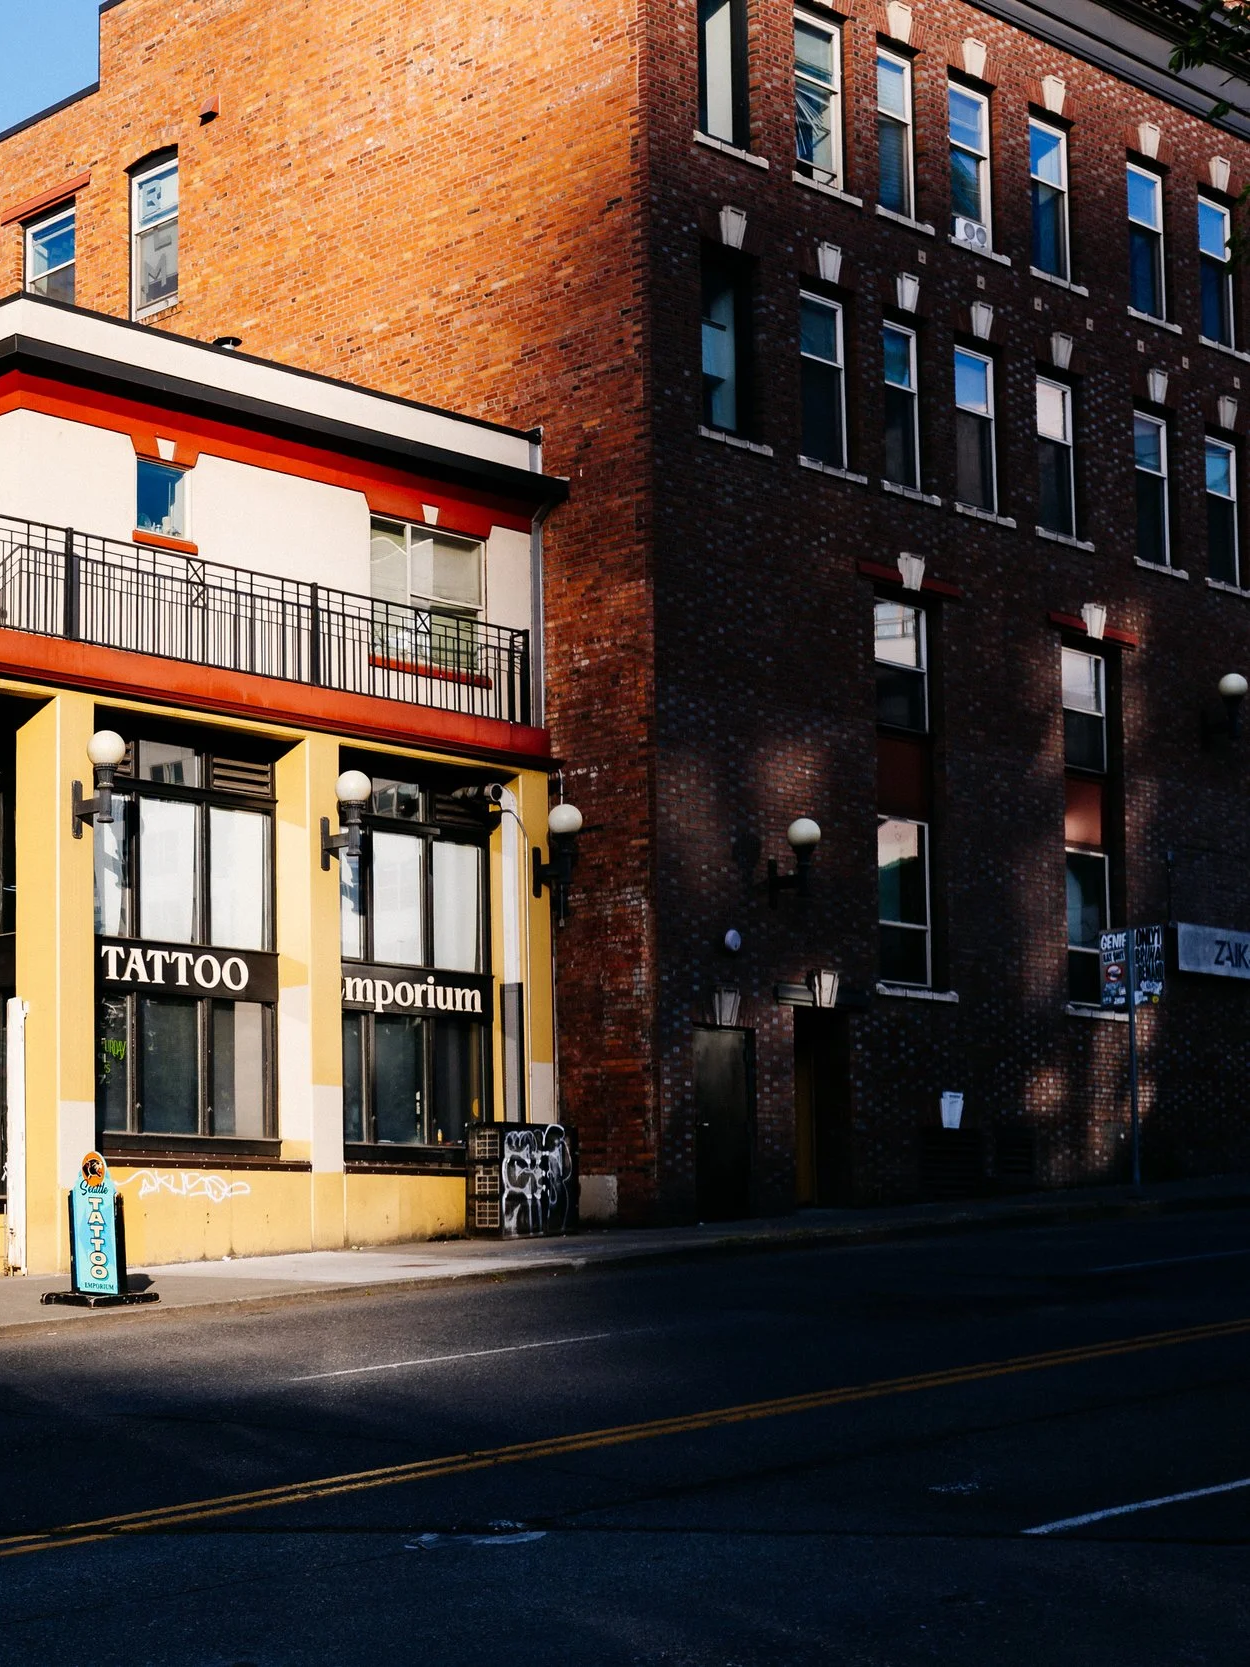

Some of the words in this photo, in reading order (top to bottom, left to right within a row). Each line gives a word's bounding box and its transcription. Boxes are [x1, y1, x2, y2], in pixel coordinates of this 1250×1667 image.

[101, 945, 249, 991] TATTOO
[1214, 940, 1250, 969] ZAIK
[341, 975, 483, 1013] mporium
[80, 1179, 108, 1196] Seattle
[87, 1196, 109, 1280] TATTOO
[84, 1281, 114, 1291] EMPORIUM
